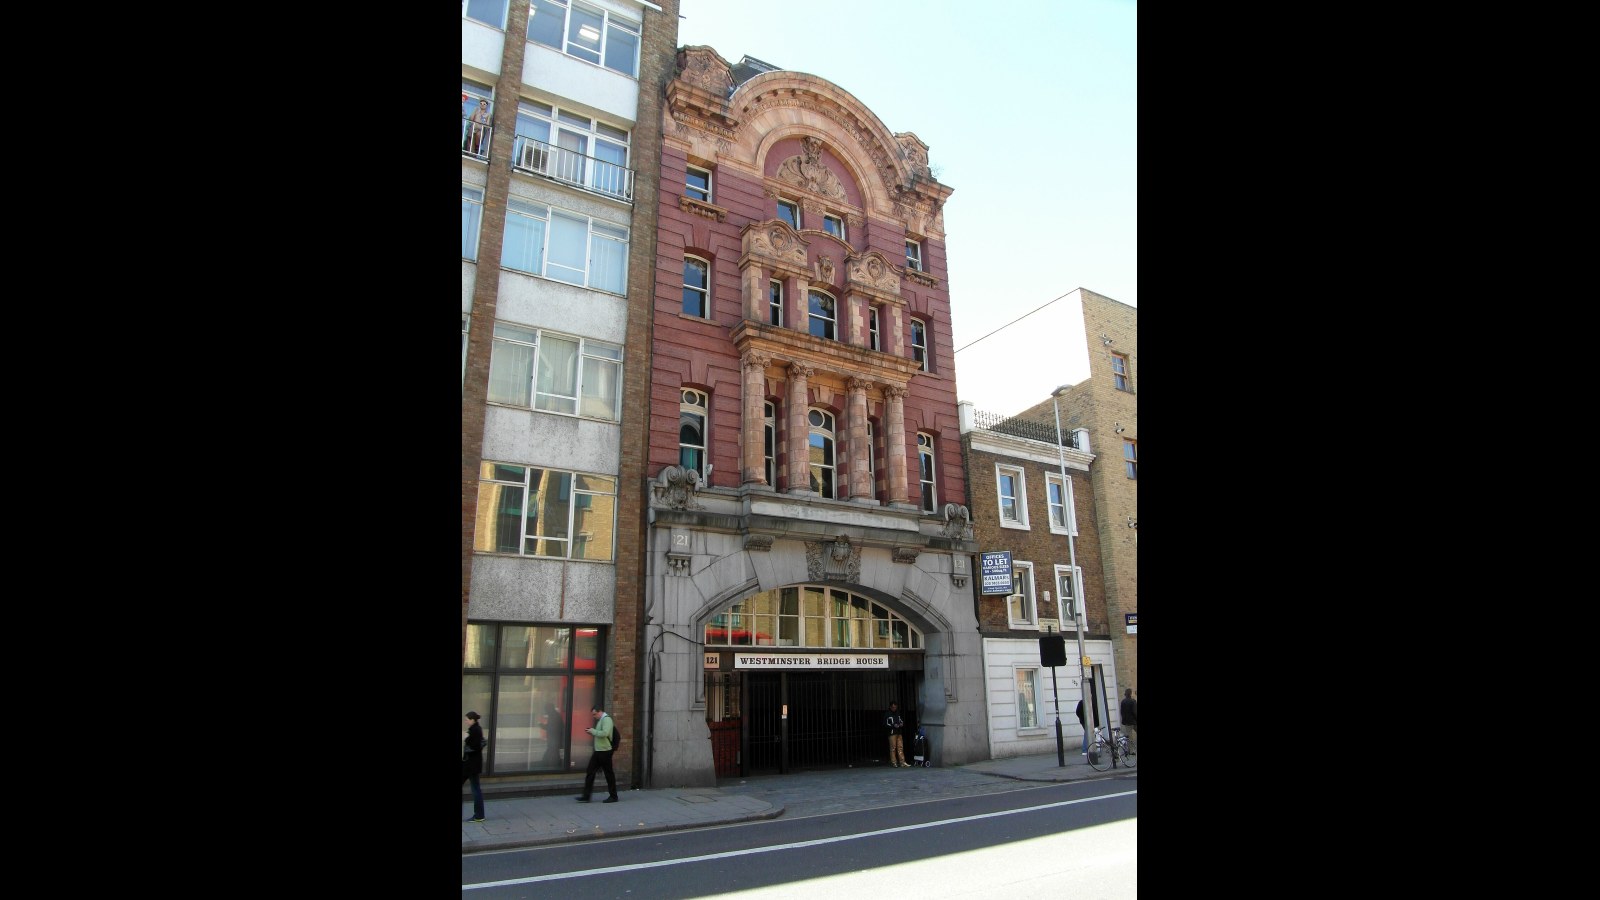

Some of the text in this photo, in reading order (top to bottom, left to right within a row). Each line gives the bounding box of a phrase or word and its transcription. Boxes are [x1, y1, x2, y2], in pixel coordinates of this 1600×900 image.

[673, 534, 688, 546] 121
[706, 656, 718, 664] 121
[740, 657, 811, 665] WESTMINSTER
